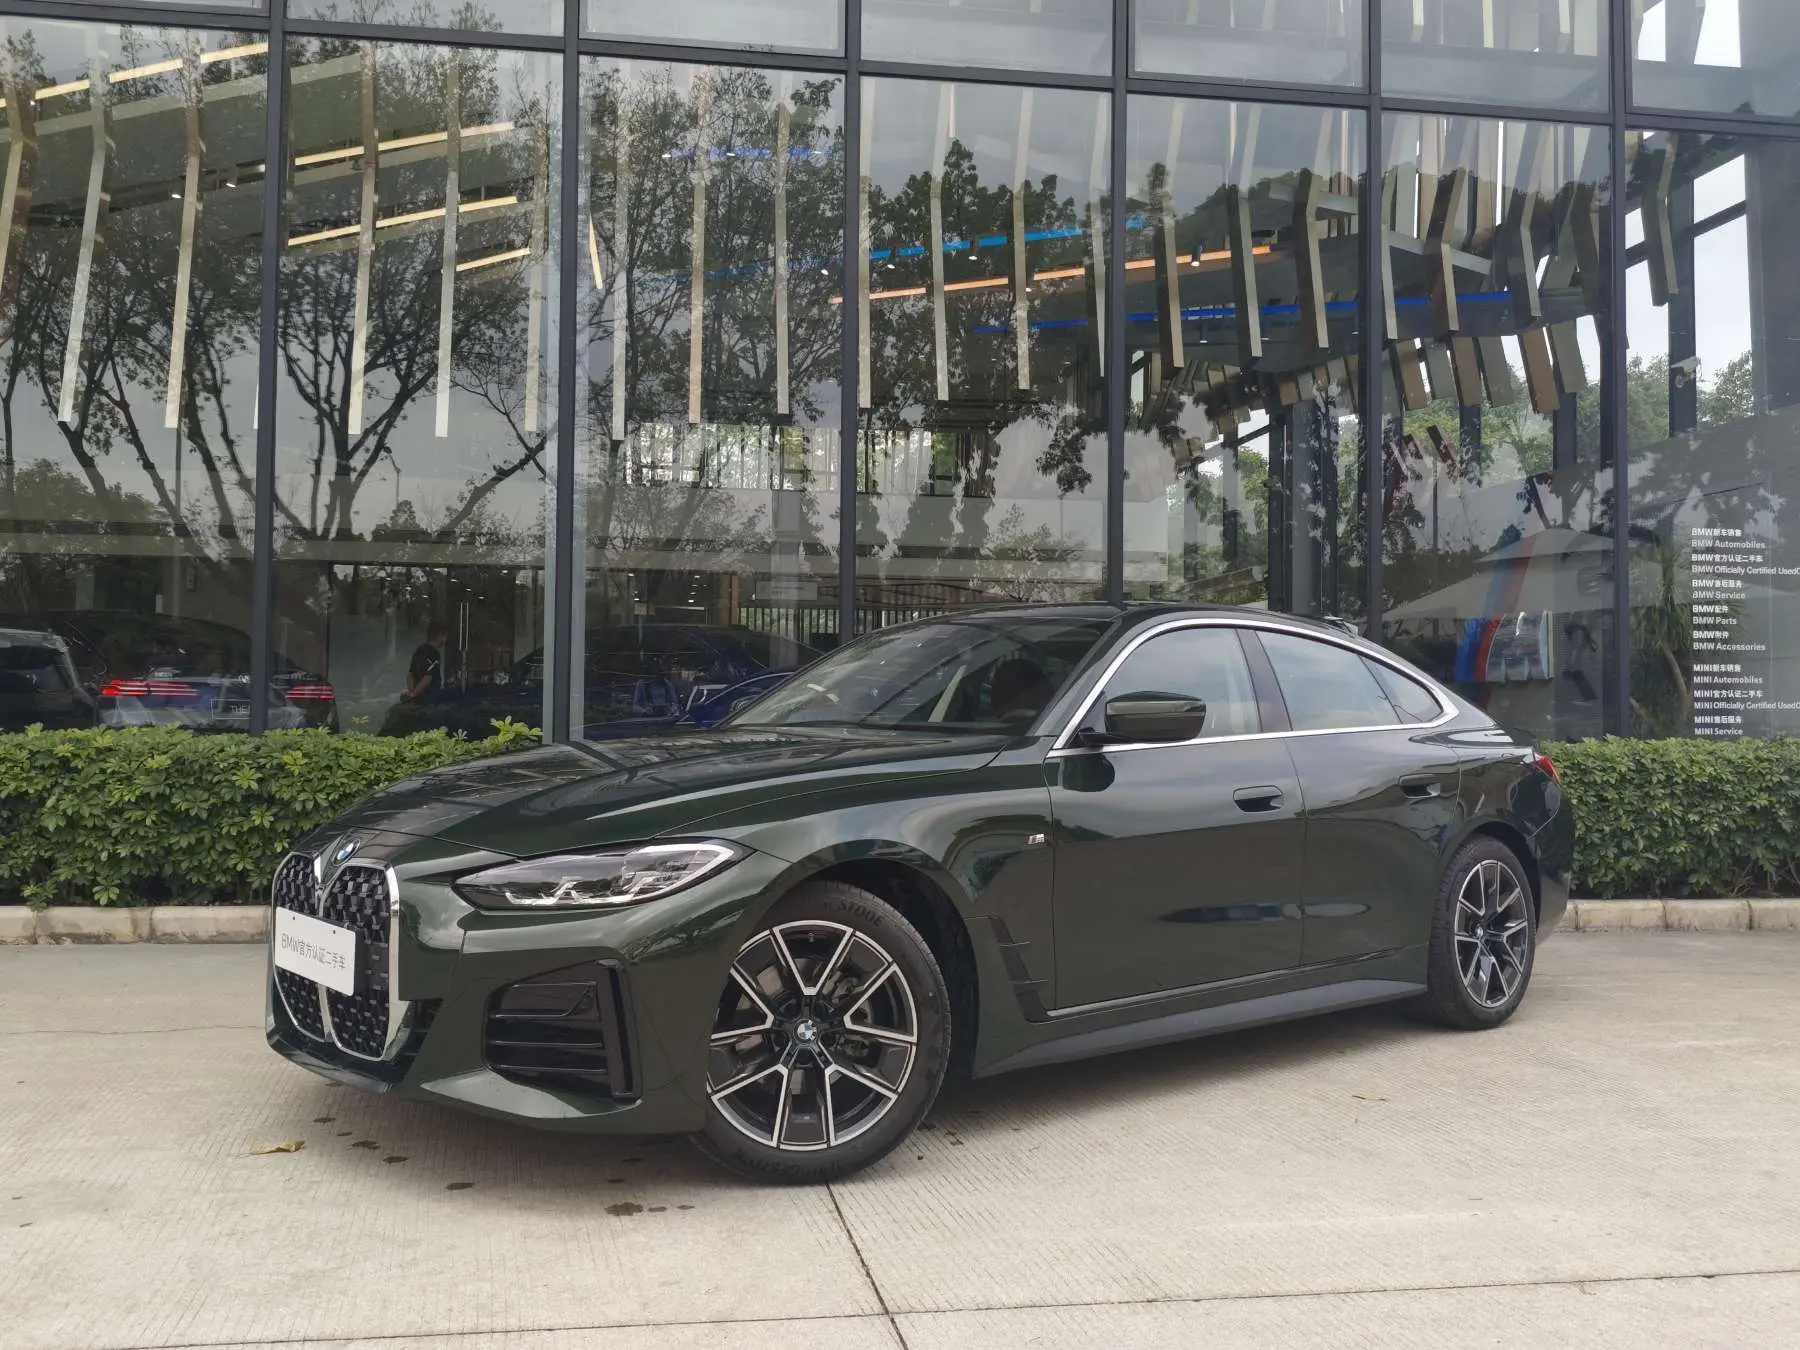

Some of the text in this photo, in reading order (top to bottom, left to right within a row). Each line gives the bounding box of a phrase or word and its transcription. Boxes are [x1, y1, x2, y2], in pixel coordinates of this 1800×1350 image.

[1691, 539, 1766, 549] BMW Automobiles
[1691, 565, 1713, 573] BMW
[1714, 565, 1745, 576] Officially
[1746, 566, 1776, 575] Certified
[1692, 590, 1746, 599] BMW Service
[1692, 616, 1737, 625] BMW Parts
[1693, 642, 1766, 651] BMW Accessories
[1693, 676, 1763, 684] MINI Automobiles
[1713, 702, 1745, 711] Officially
[1746, 702, 1776, 710] Certified
[1694, 727, 1743, 735] MINI Service
